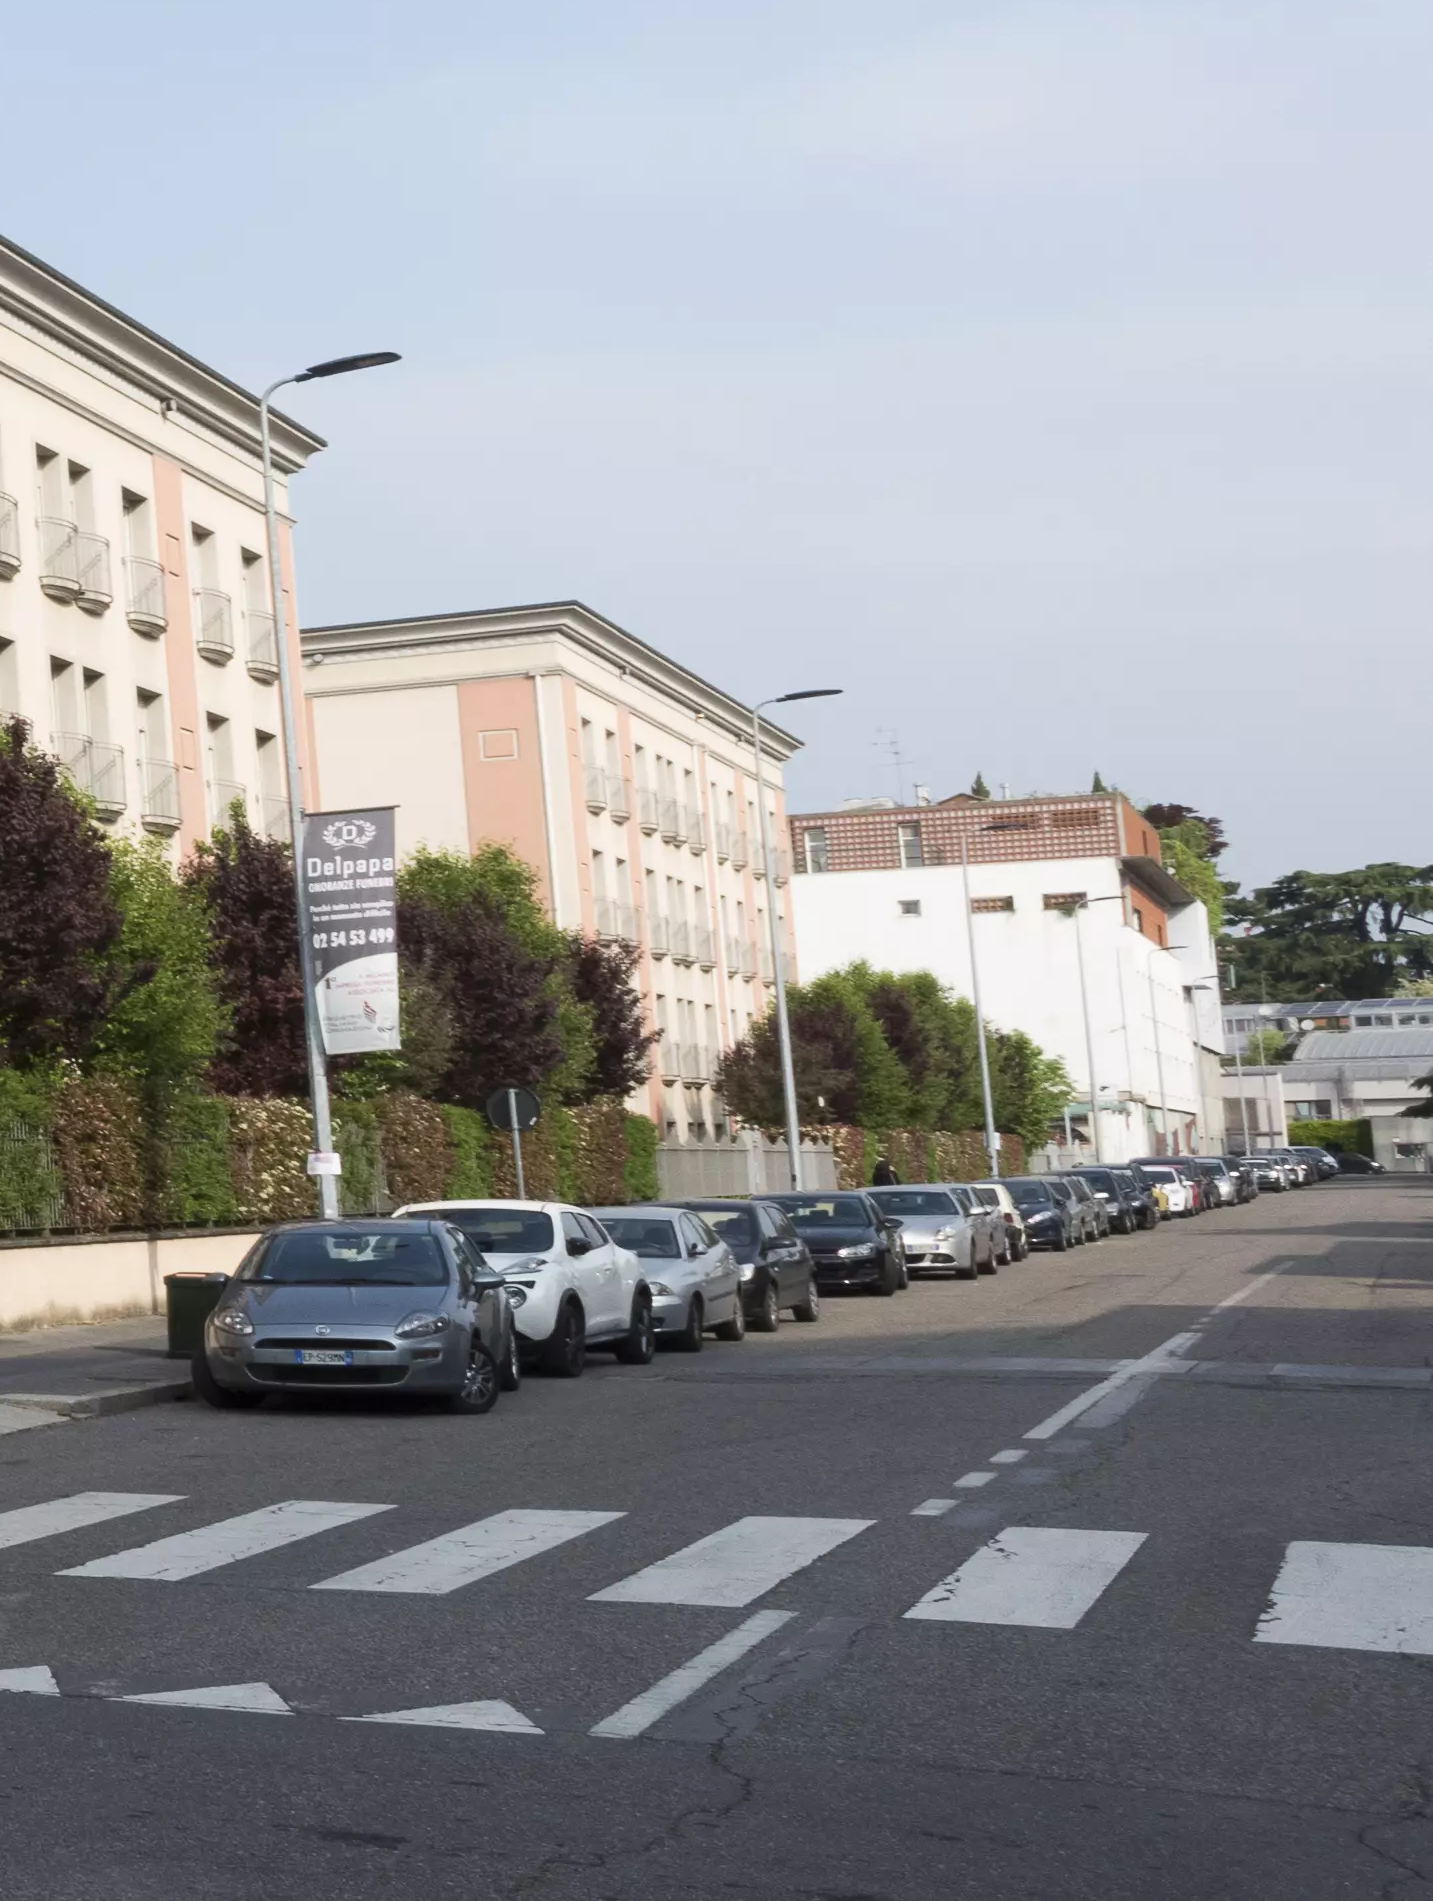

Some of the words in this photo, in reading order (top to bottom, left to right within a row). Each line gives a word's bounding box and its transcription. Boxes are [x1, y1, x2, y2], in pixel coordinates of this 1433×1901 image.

[342, 825, 358, 840] D
[307, 855, 394, 878] Delpapa
[313, 933, 328, 949] 02
[330, 931, 347, 947] 54
[349, 929, 366, 946] 53
[369, 927, 394, 944] 499
